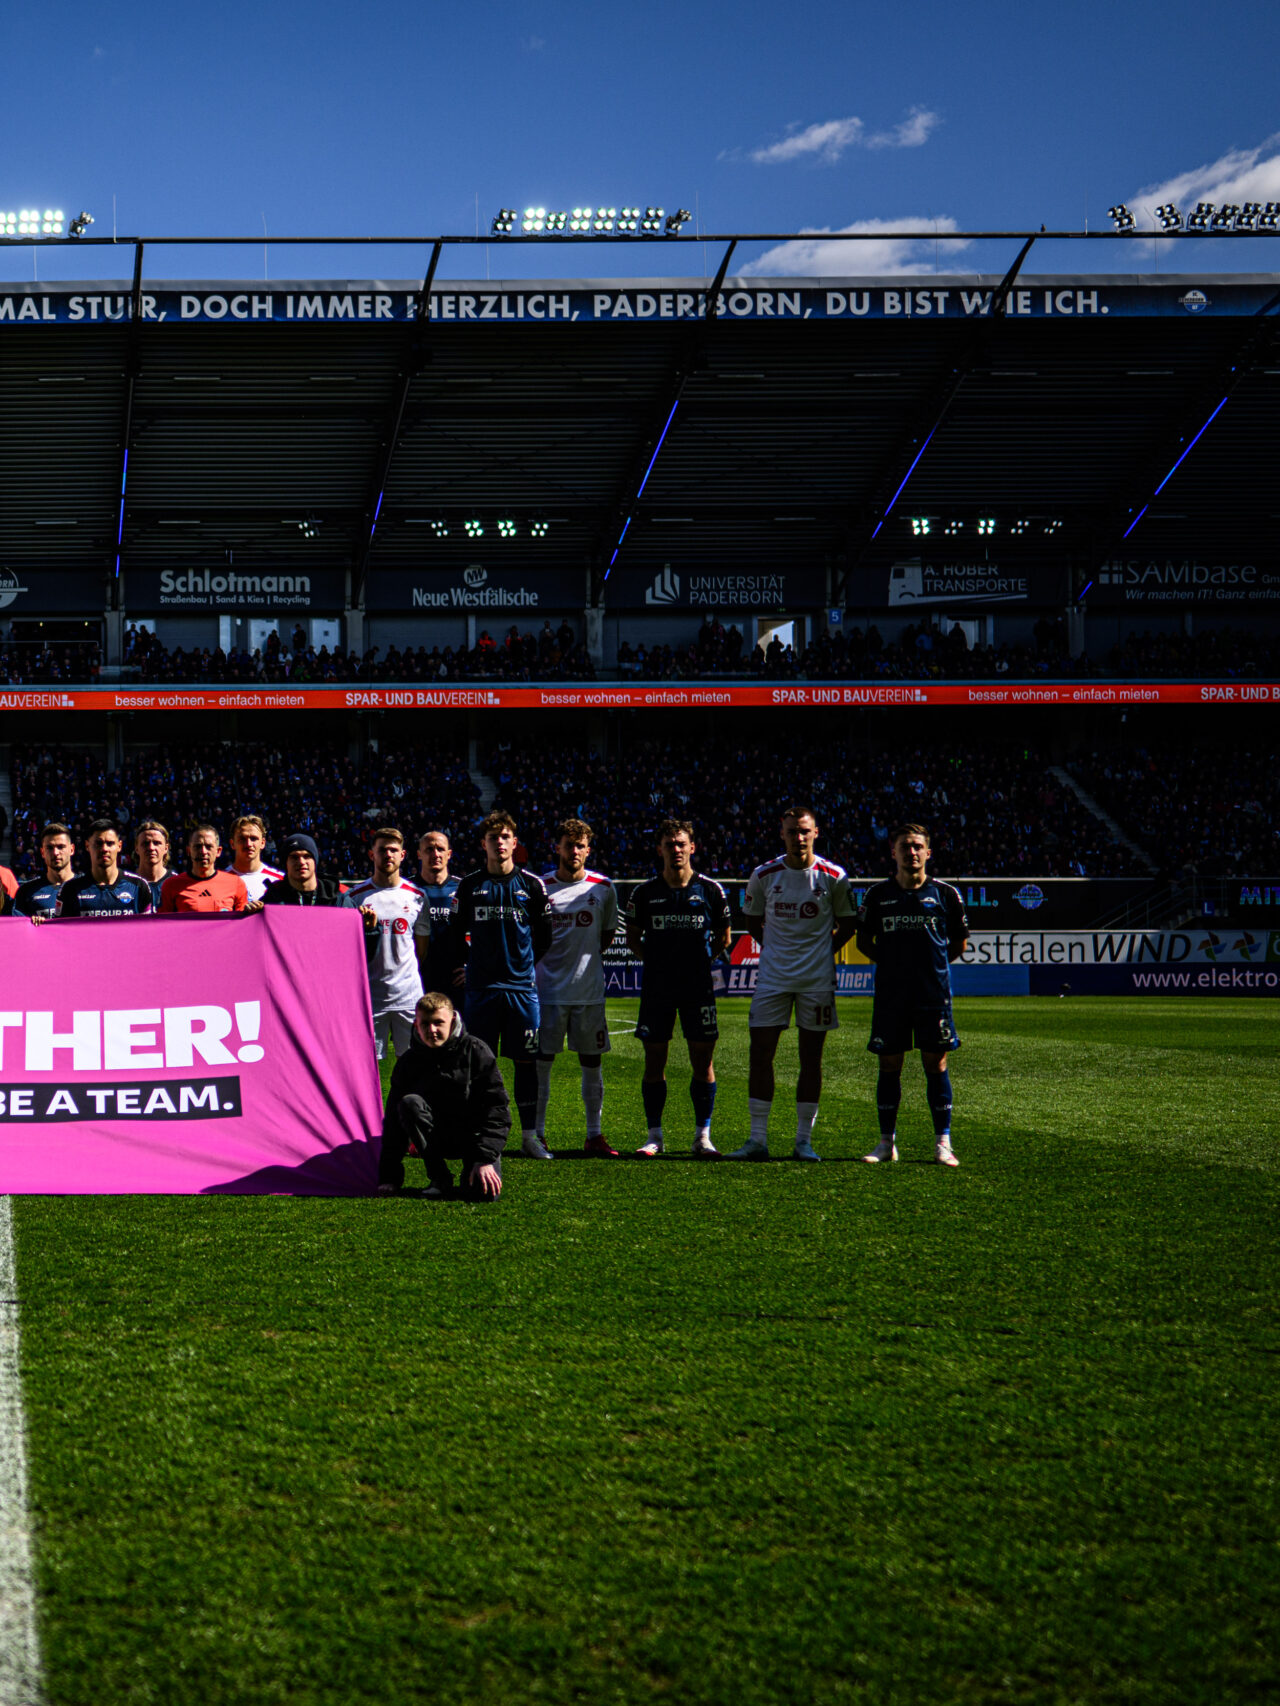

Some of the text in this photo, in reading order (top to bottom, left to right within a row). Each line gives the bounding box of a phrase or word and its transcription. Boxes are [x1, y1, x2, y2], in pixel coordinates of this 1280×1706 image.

[67, 295, 168, 322] STUR,
[180, 295, 271, 319] DOCH
[286, 294, 394, 319] IMMER
[407, 294, 580, 322] HERZLICH,
[593, 292, 813, 320] PADERBORN,
[826, 291, 871, 316] DU
[883, 290, 950, 315] BIST
[960, 290, 1031, 314] WIE
[1044, 290, 1110, 314] ICH.
[1125, 560, 1257, 584] SAMbase
[160, 568, 311, 593] Schlotmann
[689, 574, 786, 590] UNIVERSITÄT
[924, 579, 1029, 592] TRANSPORTE
[412, 587, 539, 607] Neue Westfälische
[689, 591, 783, 605] PADERBORN
[832, 611, 839, 622] 5
[115, 693, 304, 707] besser wohnen einfach mieten
[345, 692, 486, 706] SPAR- UND BAUVEREIN
[541, 691, 731, 705] besser wohnen einfach mieten
[772, 689, 913, 703] SPAR- UND BAUVEREIN
[968, 688, 1159, 701] besser wohnen einfach mieten
[1201, 687, 1238, 701] SPAR-
[1241, 687, 1269, 700] UND
[775, 902, 798, 911] REWE
[1205, 902, 1213, 914] L
[691, 915, 705, 923] 20
[896, 916, 924, 924] FOUR
[959, 932, 1191, 962] estfalenWIND
[814, 1006, 831, 1025] 19
[596, 1030, 605, 1049] 9
[45, 1089, 80, 1115] A
[87, 1084, 235, 1115] TEAM.
